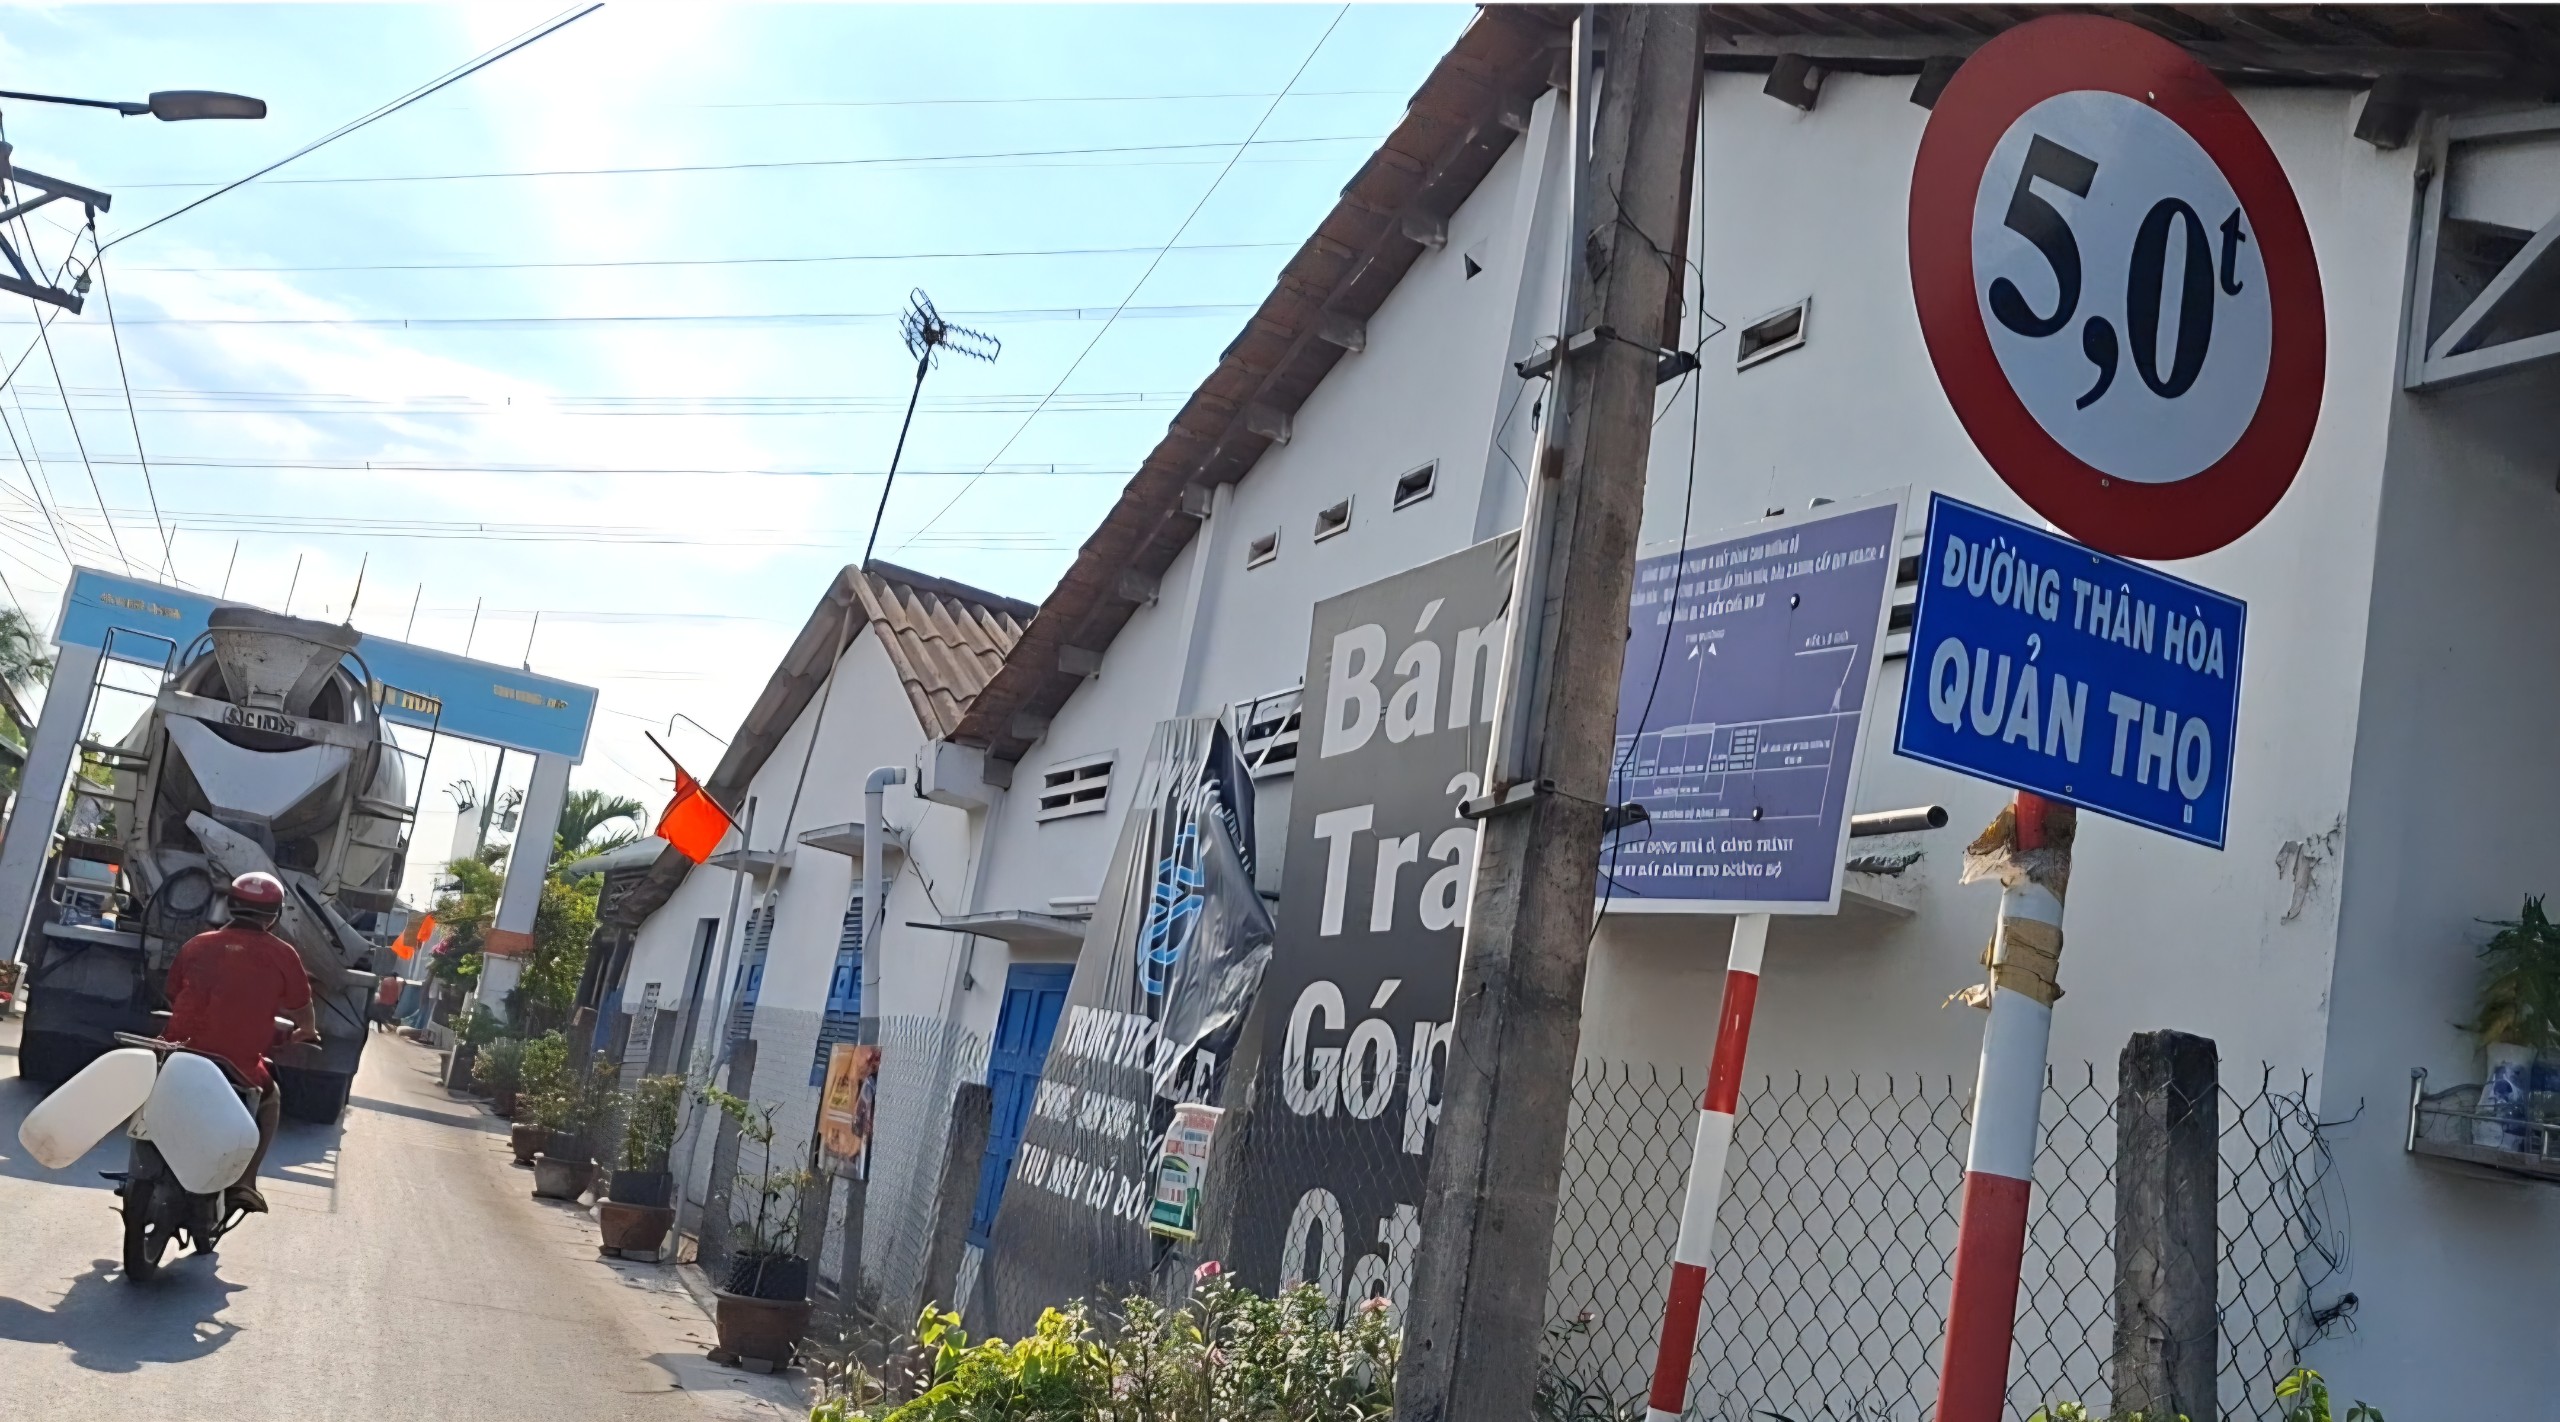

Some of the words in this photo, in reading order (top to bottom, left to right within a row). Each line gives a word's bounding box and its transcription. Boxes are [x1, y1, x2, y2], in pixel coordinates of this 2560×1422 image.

[1319, 597, 1508, 759] Bán
[1942, 534, 2060, 622] ĐƯỜNG
[2073, 583, 2156, 654] THÂN
[2163, 604, 2225, 679] HÒA
[1929, 633, 2089, 764] QUẢN
[2108, 691, 2212, 823] THỌ
[1314, 771, 1482, 937] Trả
[1282, 978, 1454, 1156] Góp
